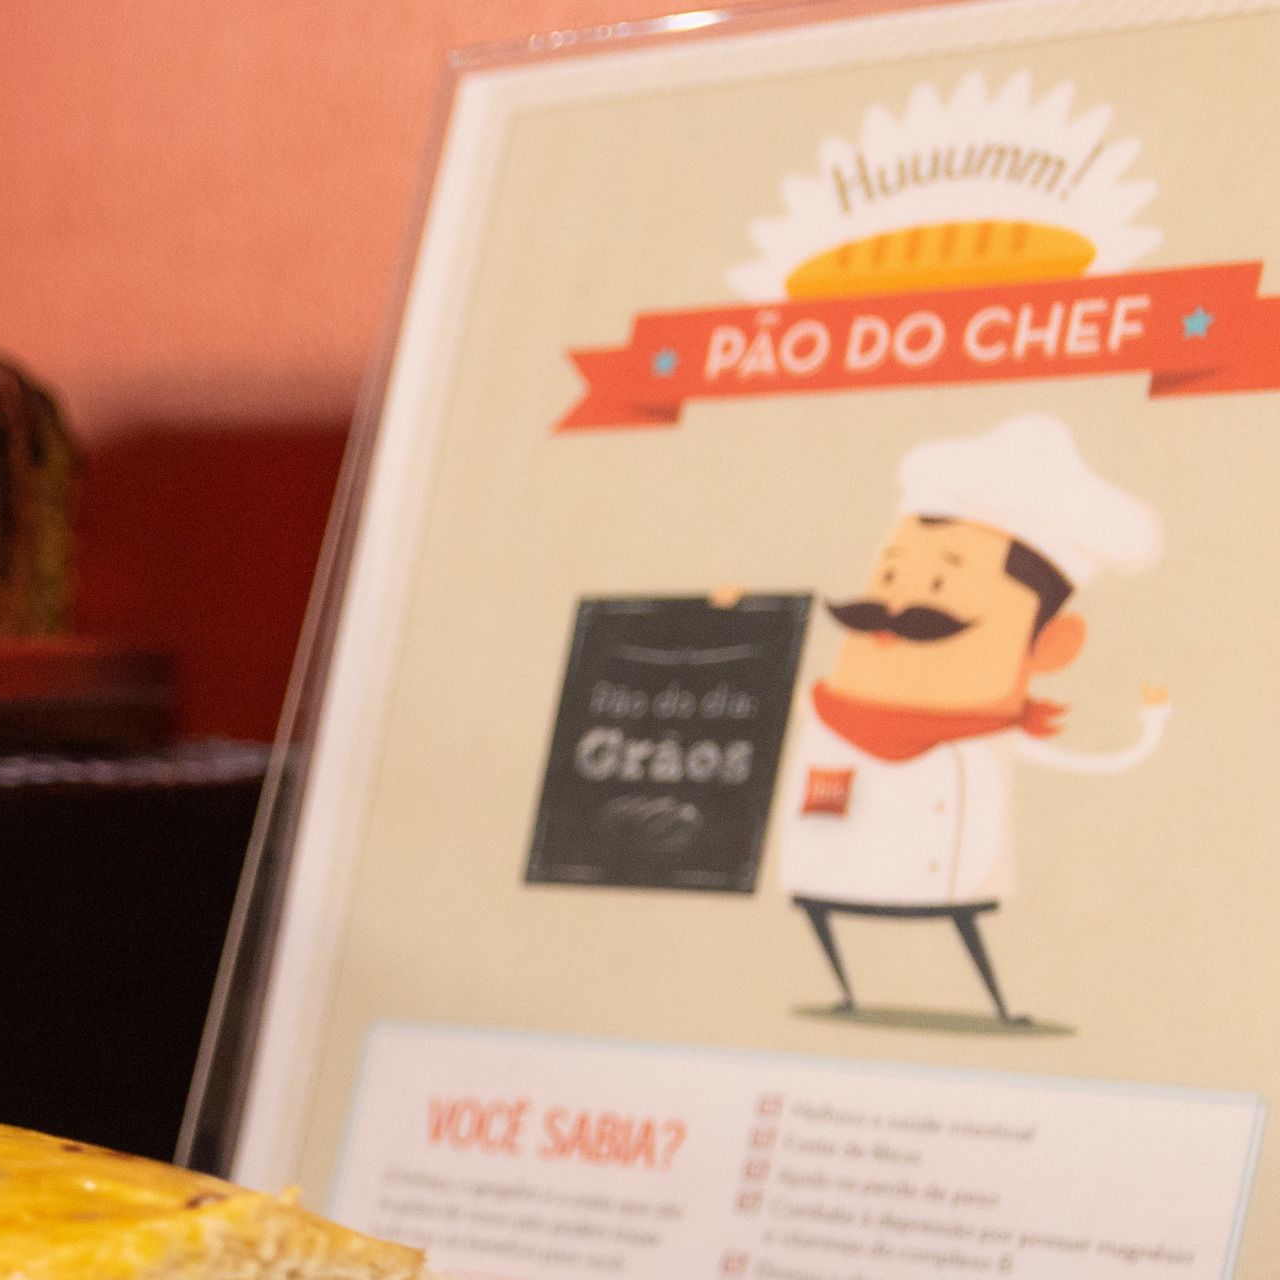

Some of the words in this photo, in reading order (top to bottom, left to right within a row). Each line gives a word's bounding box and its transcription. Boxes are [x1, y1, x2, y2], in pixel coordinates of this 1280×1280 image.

[832, 139, 1103, 214] Huuumm!
[705, 310, 830, 381] PÃO
[845, 311, 944, 371] DO
[964, 296, 1151, 362] CHEF
[591, 682, 647, 718] Pão
[652, 682, 695, 718] do
[575, 728, 754, 783] Grãos
[427, 1094, 531, 1157] VOCÊ
[537, 1105, 688, 1171] SABIA?
